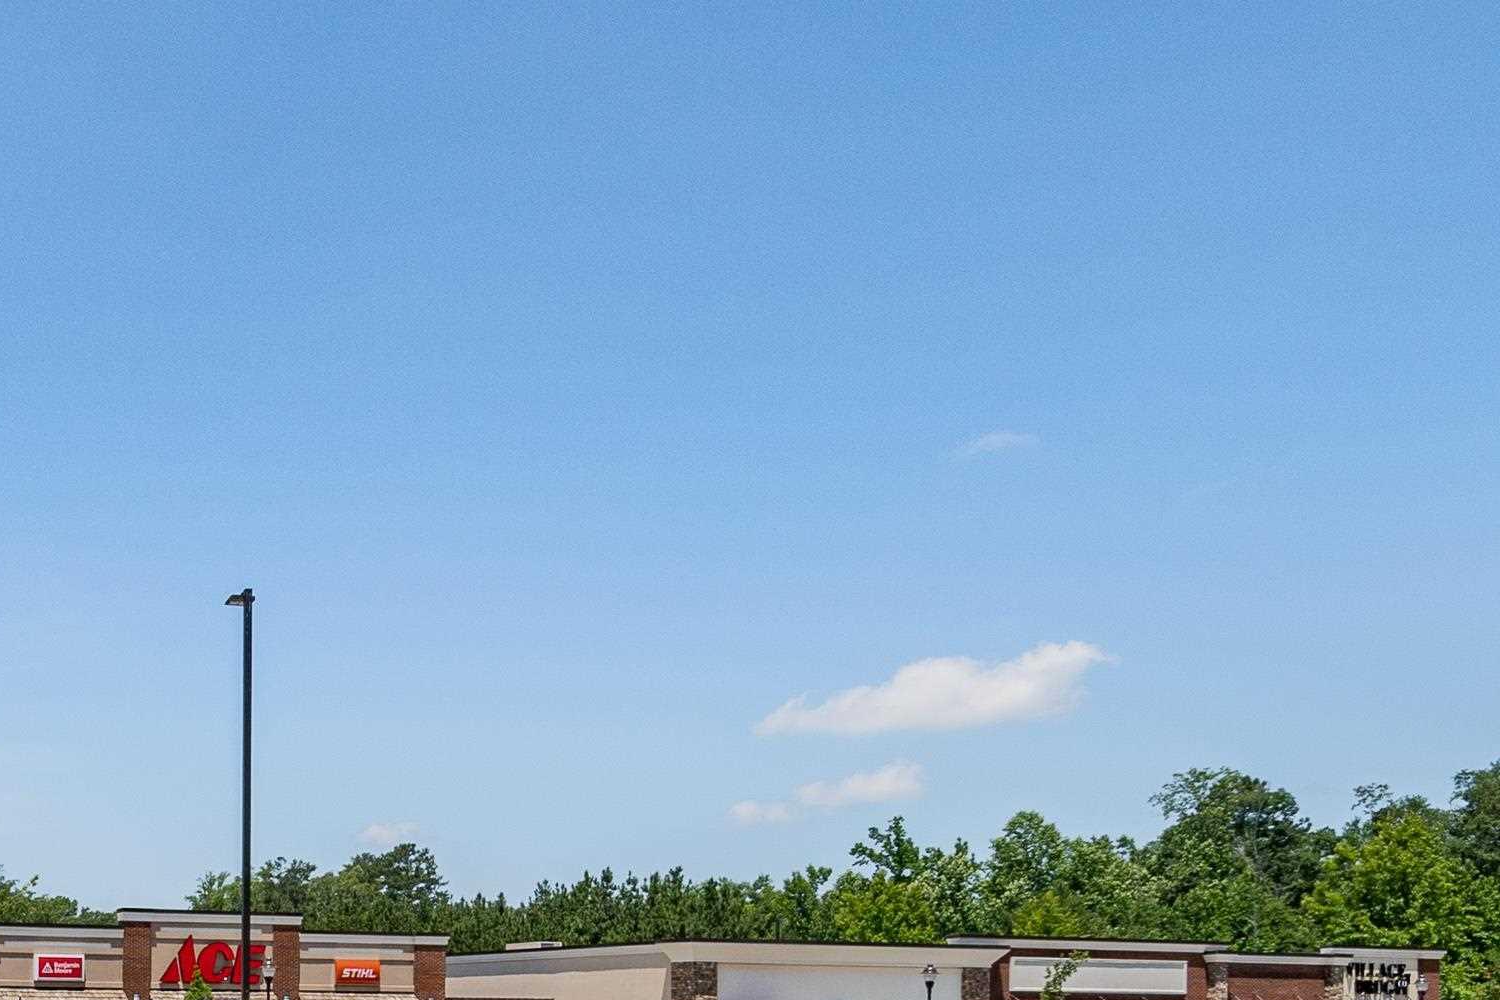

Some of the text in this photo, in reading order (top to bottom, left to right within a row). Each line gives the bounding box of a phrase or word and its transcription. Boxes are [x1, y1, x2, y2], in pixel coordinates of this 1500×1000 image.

[53, 961, 80, 969] Benjamin
[160, 934, 266, 984] ACE
[341, 967, 377, 978] STIHL
[1346, 963, 1406, 978] VILLAGE
